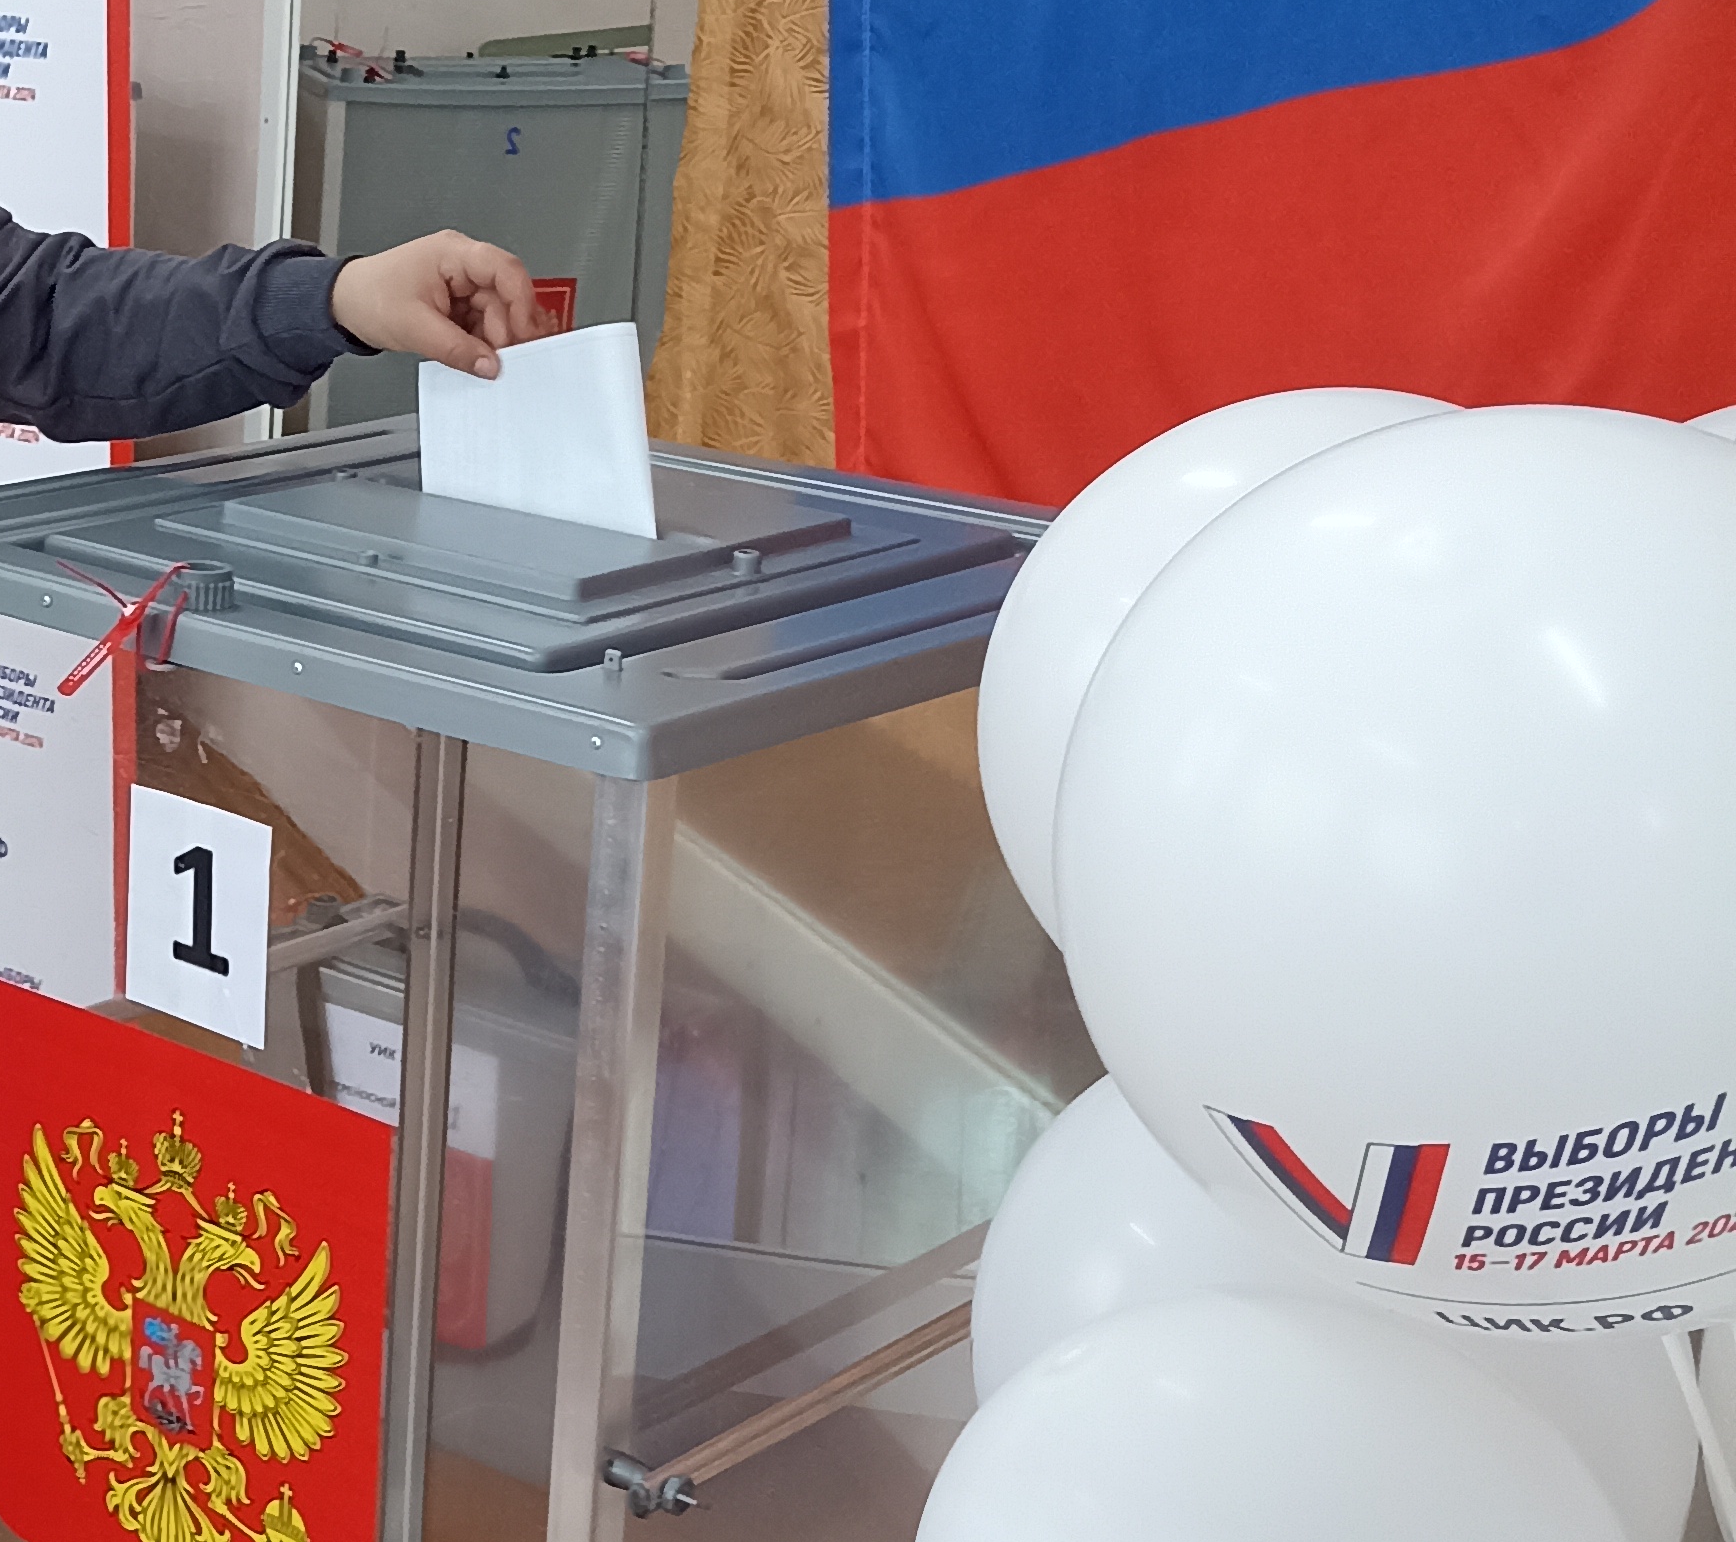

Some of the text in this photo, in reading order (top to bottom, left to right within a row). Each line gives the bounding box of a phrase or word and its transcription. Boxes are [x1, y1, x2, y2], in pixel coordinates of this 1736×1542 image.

[174, 846, 230, 977] 1
[1483, 1091, 1727, 1175] ВЫБОРЫ
[1460, 1200, 1668, 1248] РОССИИ
[1453, 1252, 1548, 1271] 15–17
[1553, 1231, 1675, 1269] МАРТА
[1434, 1304, 1694, 1332] ЦИК.РФ
